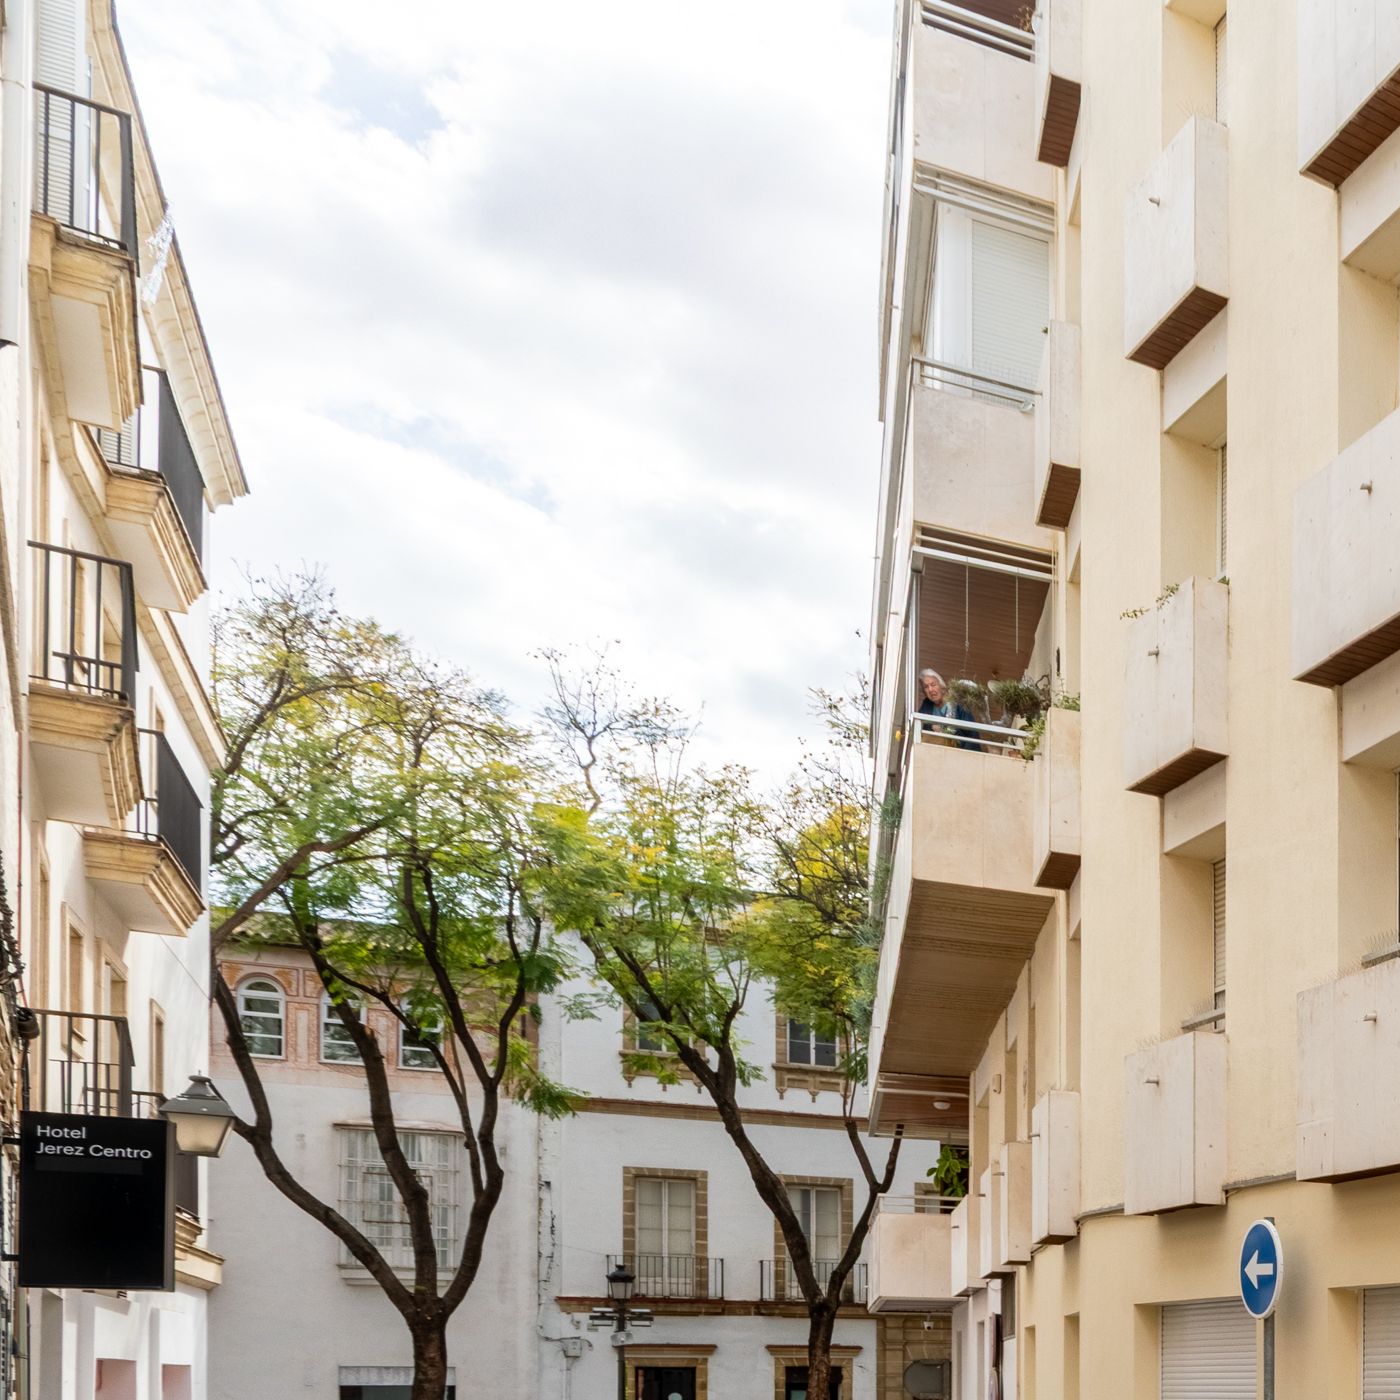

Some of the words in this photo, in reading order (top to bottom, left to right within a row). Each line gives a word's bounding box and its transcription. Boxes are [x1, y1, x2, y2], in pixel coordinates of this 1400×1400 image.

[36, 1125, 87, 1139] Hotel
[35, 1142, 84, 1156] Jerez
[89, 1144, 152, 1159] Centro
